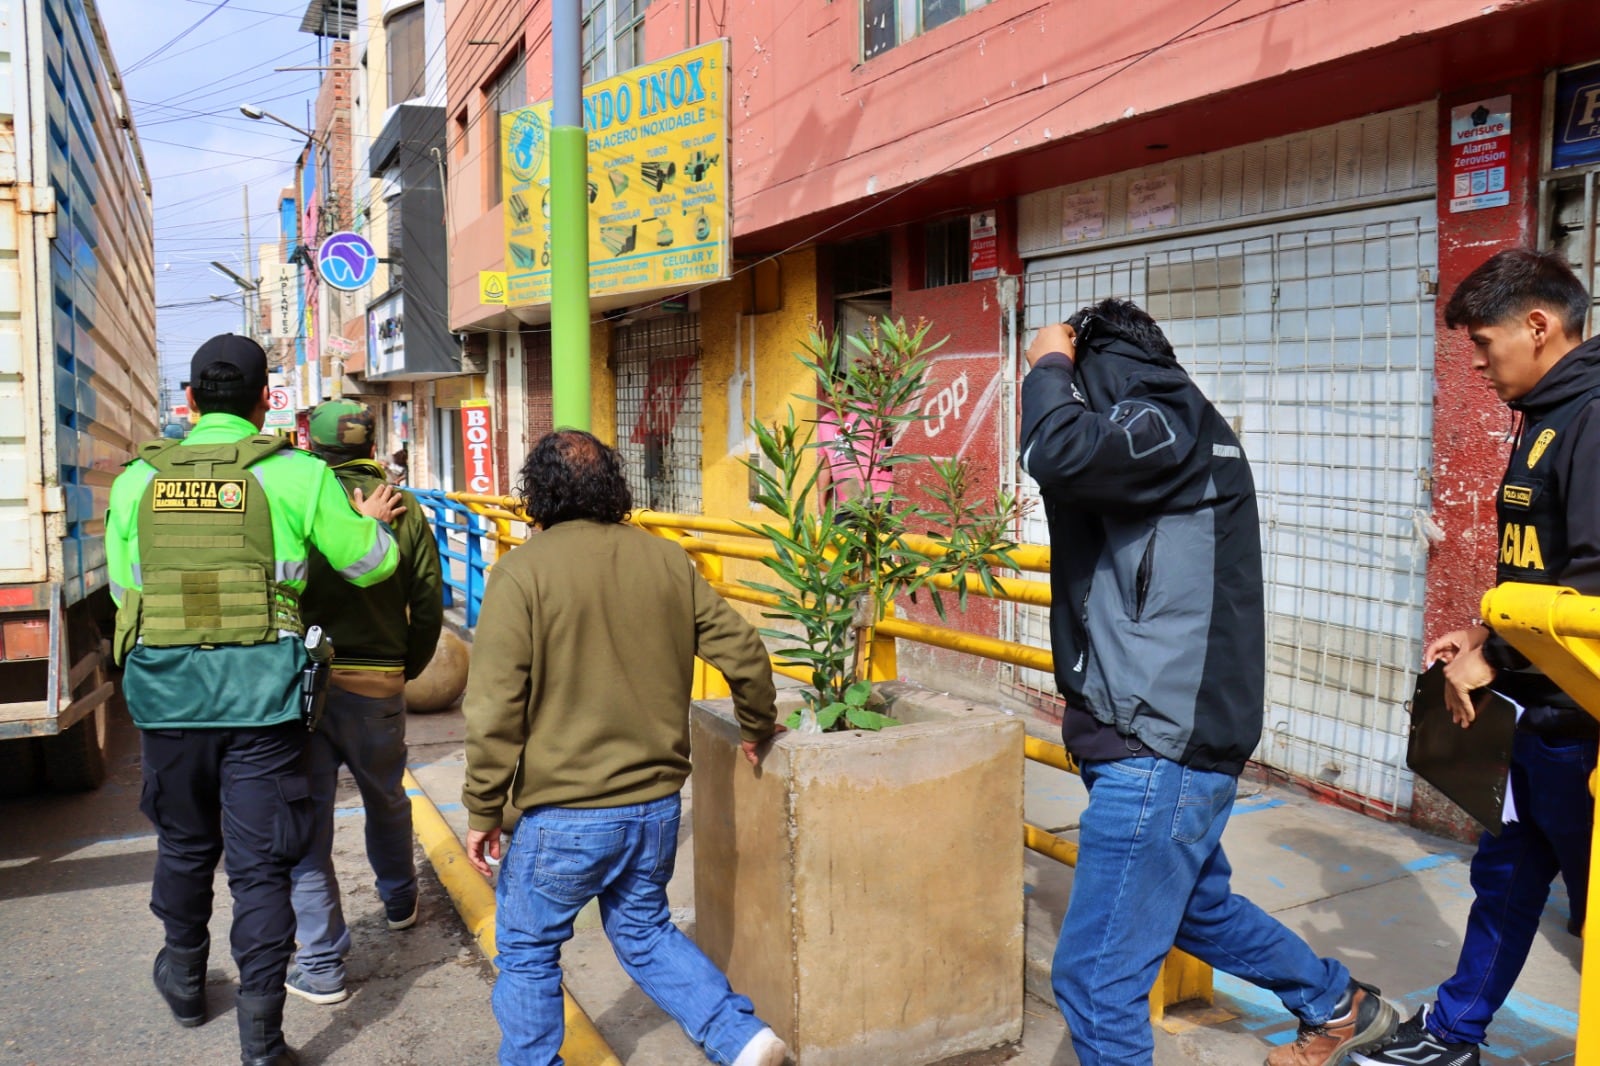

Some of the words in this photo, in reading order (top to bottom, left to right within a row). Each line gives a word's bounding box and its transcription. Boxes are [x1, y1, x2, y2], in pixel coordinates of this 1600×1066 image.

[639, 60, 705, 118] INOX
[589, 139, 602, 153] EN
[603, 127, 637, 150] ACERO
[640, 108, 706, 136] INOXIDABLE
[1457, 122, 1504, 139] verisure
[1454, 151, 1506, 168] Zerovision
[1462, 141, 1497, 155] Alarma
[662, 251, 704, 267] CELULAR
[707, 250, 714, 260] Y
[279, 267, 289, 334] IMPLANTES
[923, 378, 969, 438] CPP
[466, 410, 490, 495] BOTIC
[156, 482, 217, 498] POLICIA
